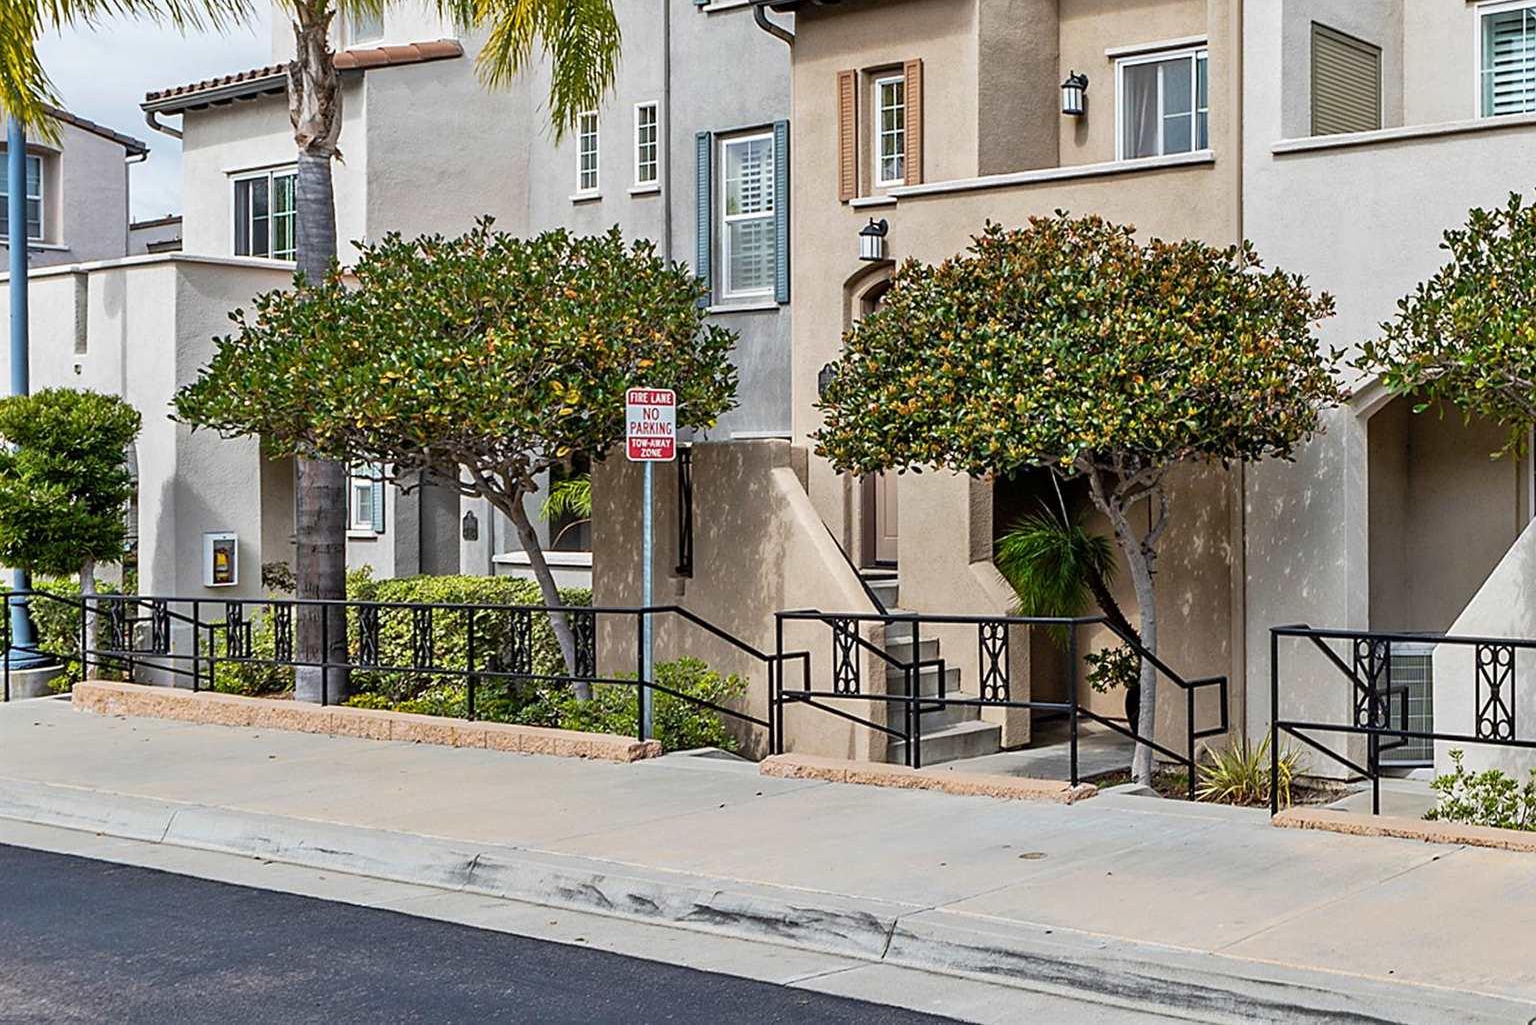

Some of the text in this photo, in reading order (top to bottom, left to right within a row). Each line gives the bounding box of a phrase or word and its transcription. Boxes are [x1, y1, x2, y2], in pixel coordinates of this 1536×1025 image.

[629, 392, 672, 404] FIRE LANE
[643, 407, 659, 421] NO
[630, 422, 672, 435] PARKING
[631, 438, 671, 448] TOW-AWAY
[640, 448, 662, 457] ZONE
